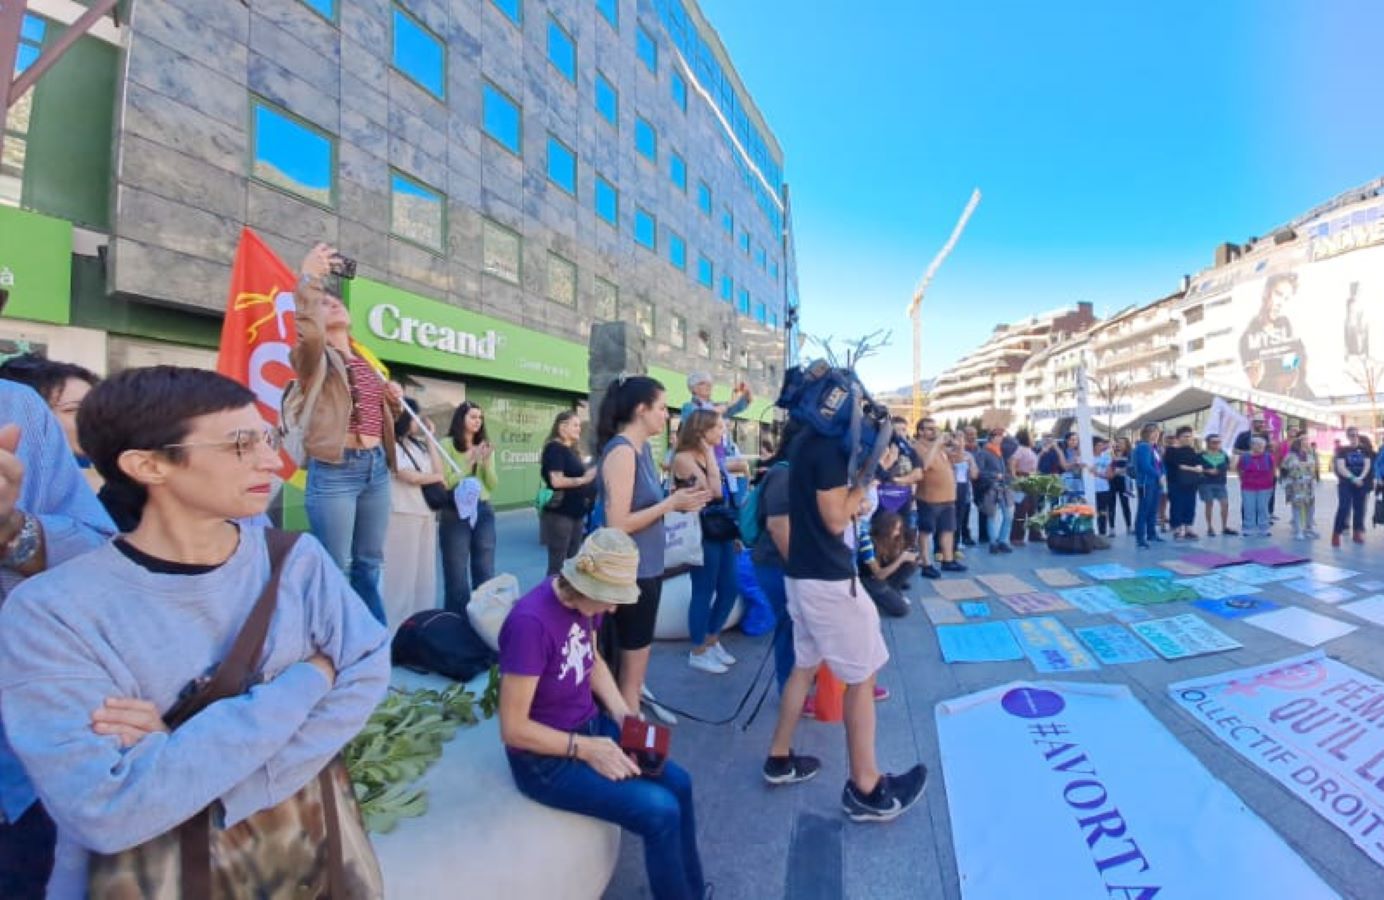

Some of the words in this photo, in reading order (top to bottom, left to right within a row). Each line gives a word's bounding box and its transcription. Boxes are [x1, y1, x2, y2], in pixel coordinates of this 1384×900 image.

[368, 303, 496, 360] Creand
[1180, 687, 1298, 766] OLLECTIF
[1269, 698, 1368, 762] QU'IL
